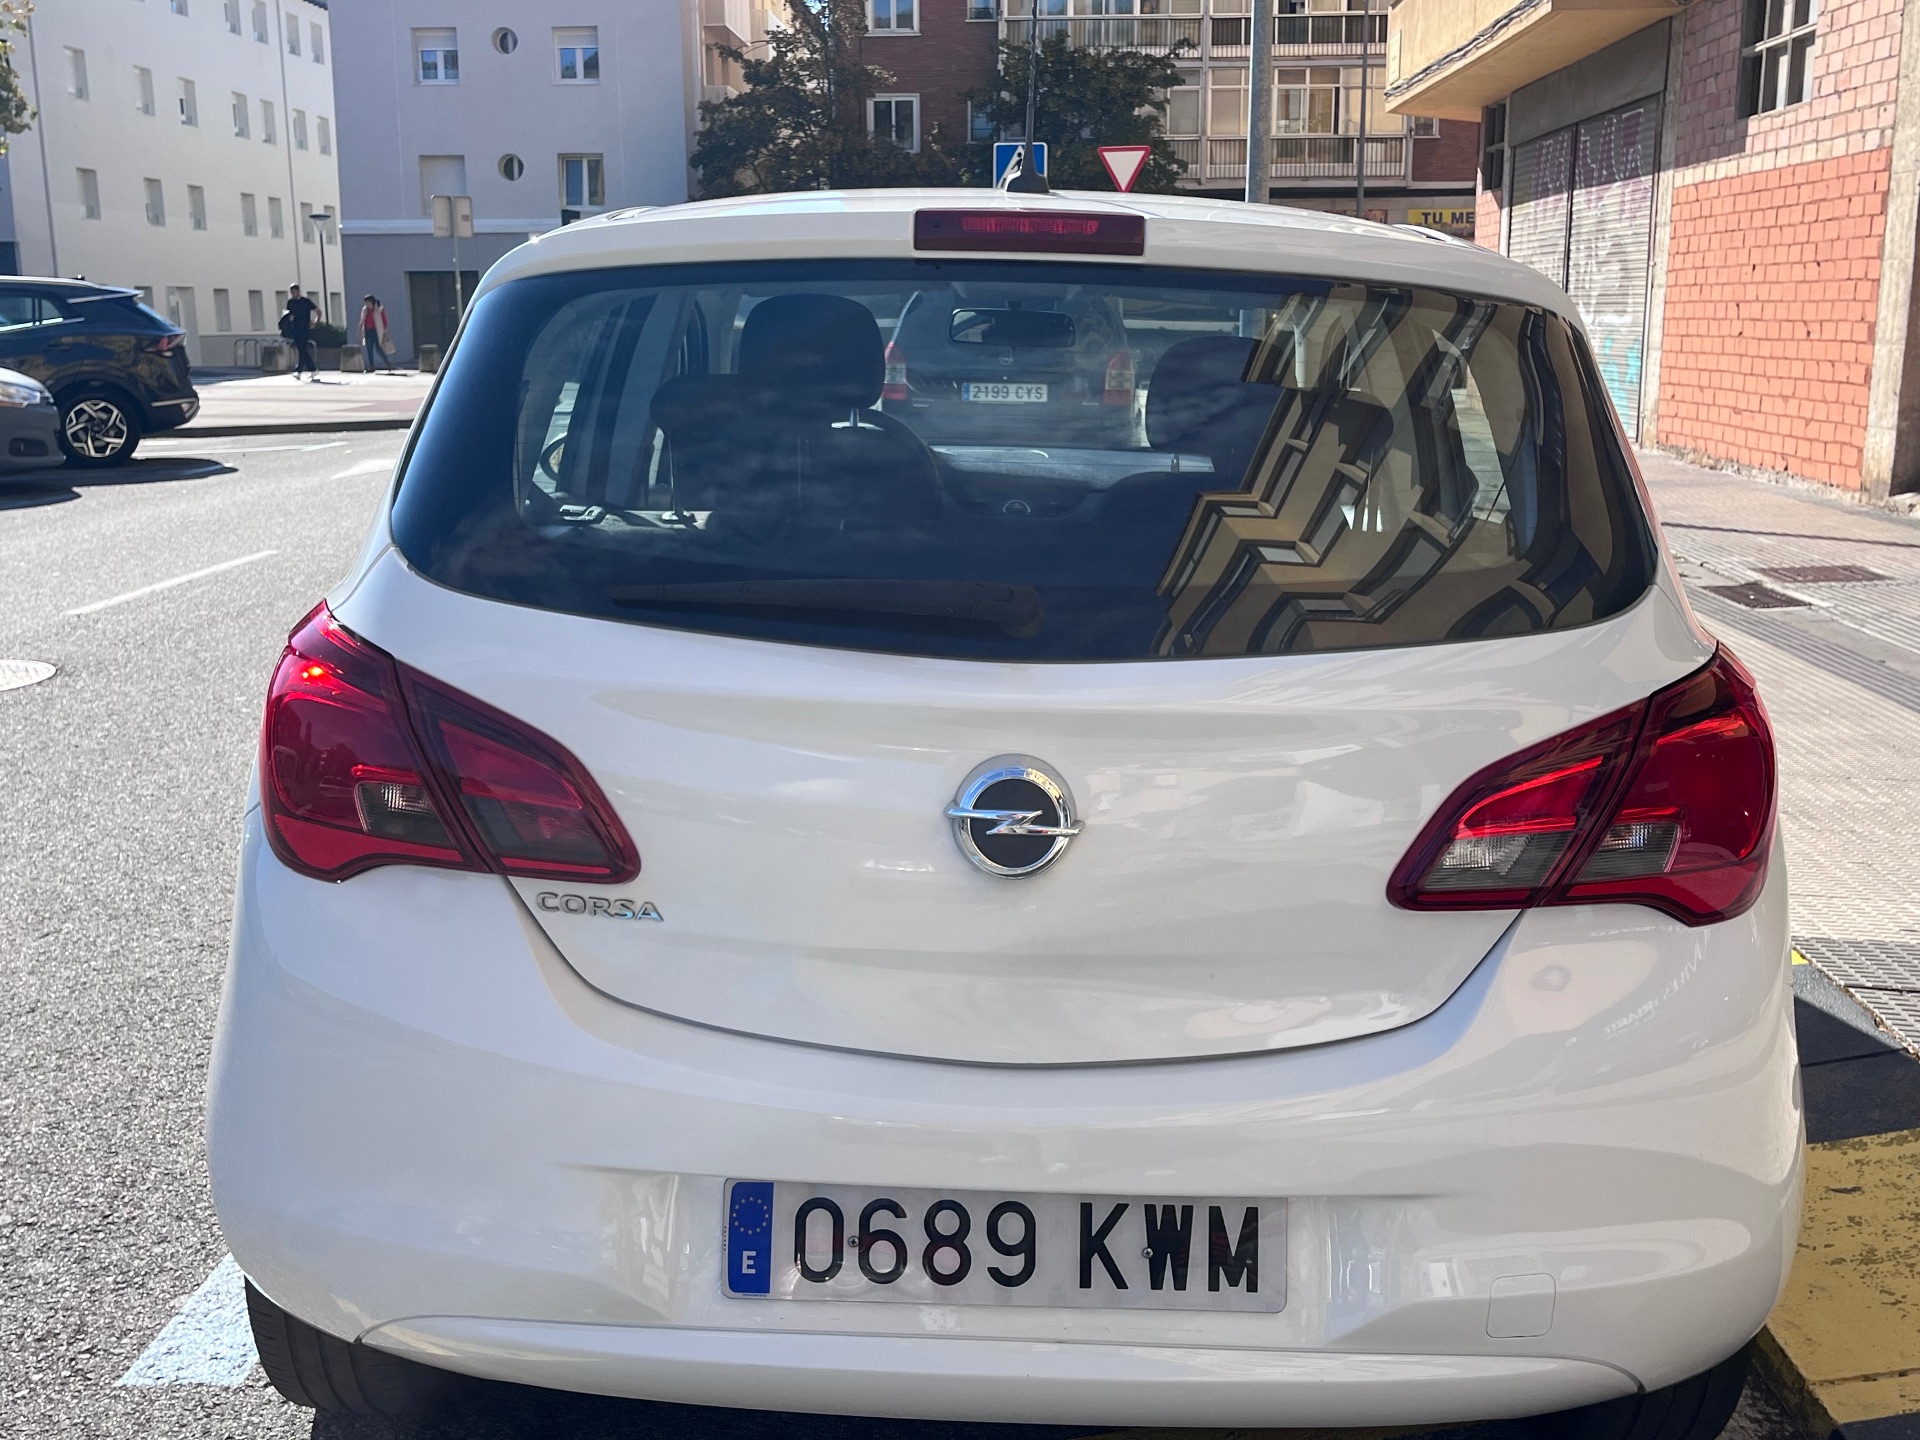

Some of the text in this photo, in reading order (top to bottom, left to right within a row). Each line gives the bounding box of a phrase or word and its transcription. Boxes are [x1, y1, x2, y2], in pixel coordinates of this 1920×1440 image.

[1421, 212, 1476, 225] TU ME
[972, 385, 1043, 400] 2199 CYS
[536, 891, 665, 922] CORSA
[793, 1196, 1259, 1294] 0689 KWM
[741, 1250, 757, 1275] E
